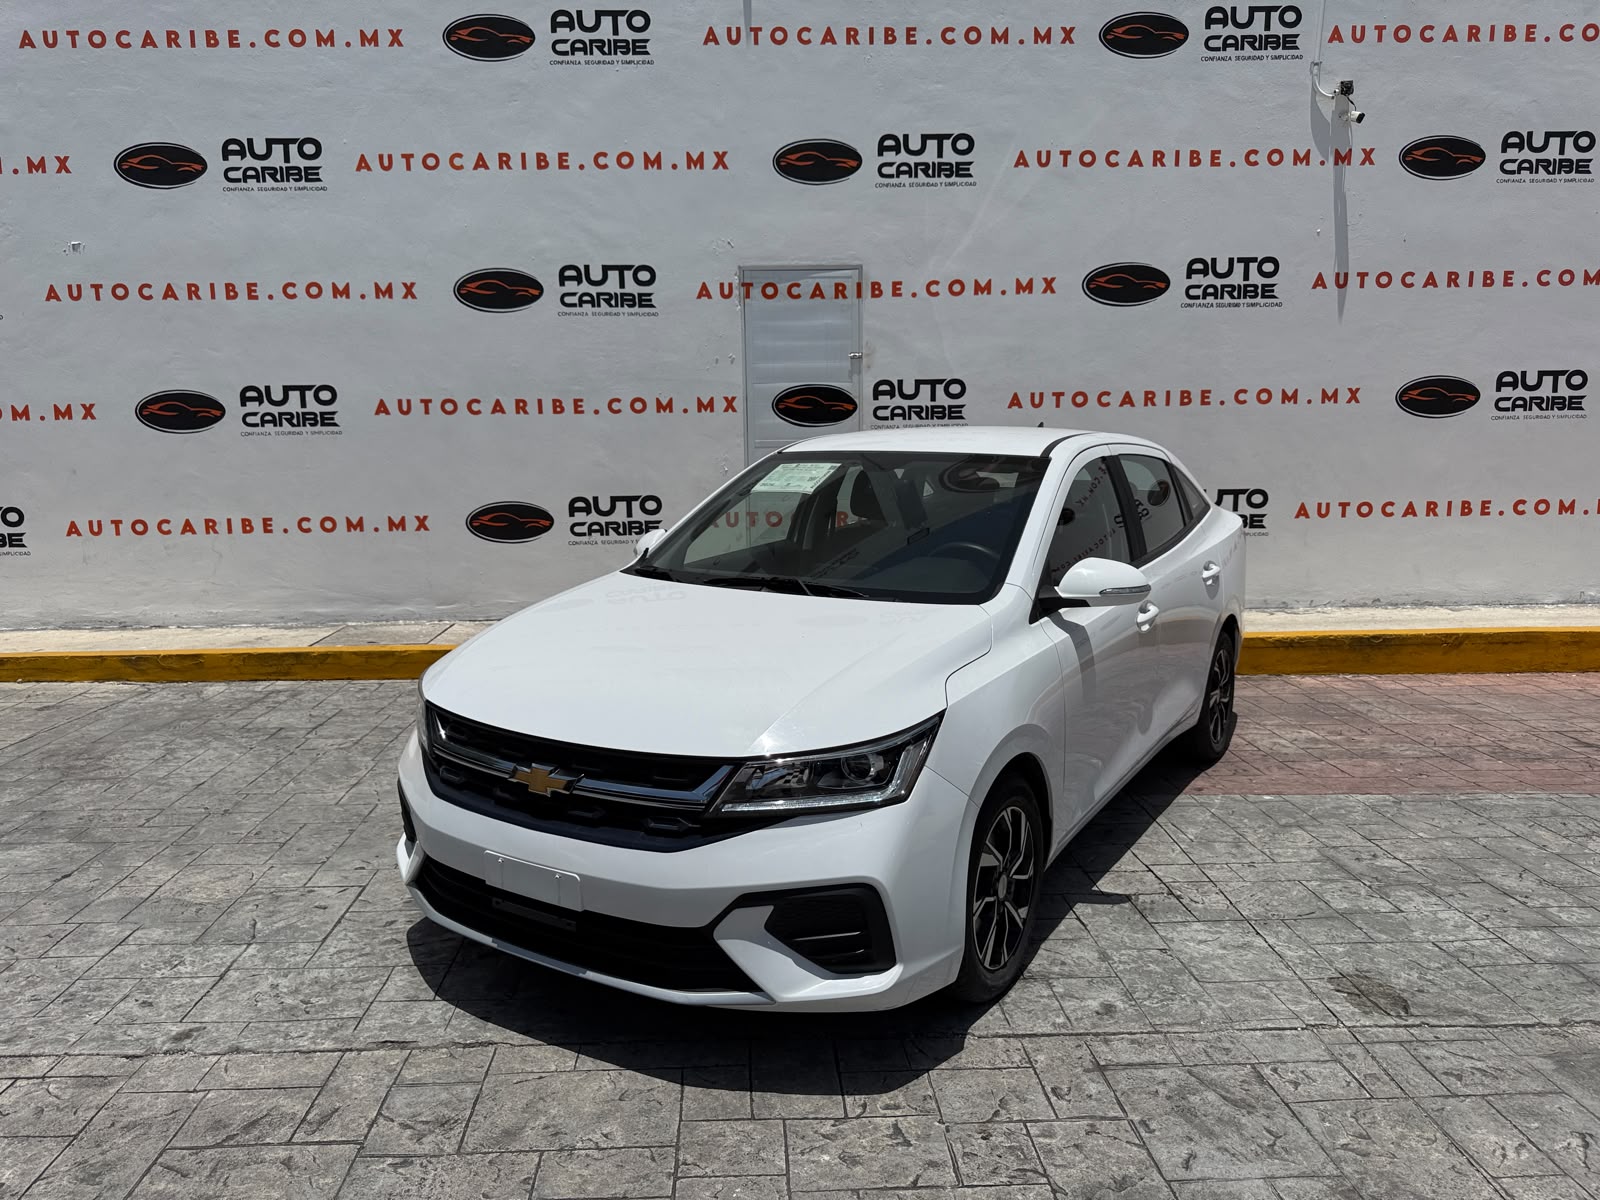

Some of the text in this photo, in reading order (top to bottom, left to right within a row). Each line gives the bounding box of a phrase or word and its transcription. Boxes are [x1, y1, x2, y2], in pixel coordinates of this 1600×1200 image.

[551, 10, 651, 36] AUTO
[1205, 5, 1302, 31] AUTO
[20, 30, 402, 49] AUTOCARIBE.COM.MX
[704, 27, 1075, 45] AUTOCARIBE.COM.MX
[1204, 34, 1300, 52] CARIBE
[1329, 24, 1600, 43] AUTOCARIBE.CO
[552, 39, 650, 56] CARIBE
[1271, 53, 1303, 61] SIMPLICIDAD
[222, 137, 322, 163] AUTO
[878, 133, 975, 158] AUTO
[1501, 131, 1596, 155] AUTO
[0, 156, 71, 174] .MX
[356, 152, 729, 171] AUTOCARIBE.COM.MX
[1015, 149, 1375, 167] AUTOCARIBE.COM.MX
[1500, 158, 1593, 175] CARIBE
[224, 166, 322, 183] CARIBE
[878, 161, 974, 178] CARIBE
[559, 265, 656, 289] AUTO
[1186, 256, 1279, 281] AUTO
[697, 278, 1056, 300] AUTOCARIBE.COM.MX
[1313, 270, 1600, 289] AUTOCARIBE.COM
[46, 282, 417, 301] AUTOCARIBE.COM.MX
[560, 292, 656, 308] CARIBE
[1185, 284, 1278, 300] CARIBE
[873, 379, 966, 402] AUTO
[1496, 370, 1588, 393] AUTO
[240, 385, 337, 408] AUTO
[1009, 390, 1361, 409] AUTOCARIBE.COM.MX
[1494, 395, 1586, 412] CARIBE
[0, 404, 97, 421] M.MX
[376, 397, 737, 416] AUTOCARIBE.COM.MX
[873, 405, 965, 421] CARIBE
[242, 411, 340, 427] CARIBE
[568, 494, 662, 518] AUTO
[1296, 499, 1600, 519] AUTOCARIBE.COM.
[67, 516, 430, 537] AUTOCARIBE.COM.MX
